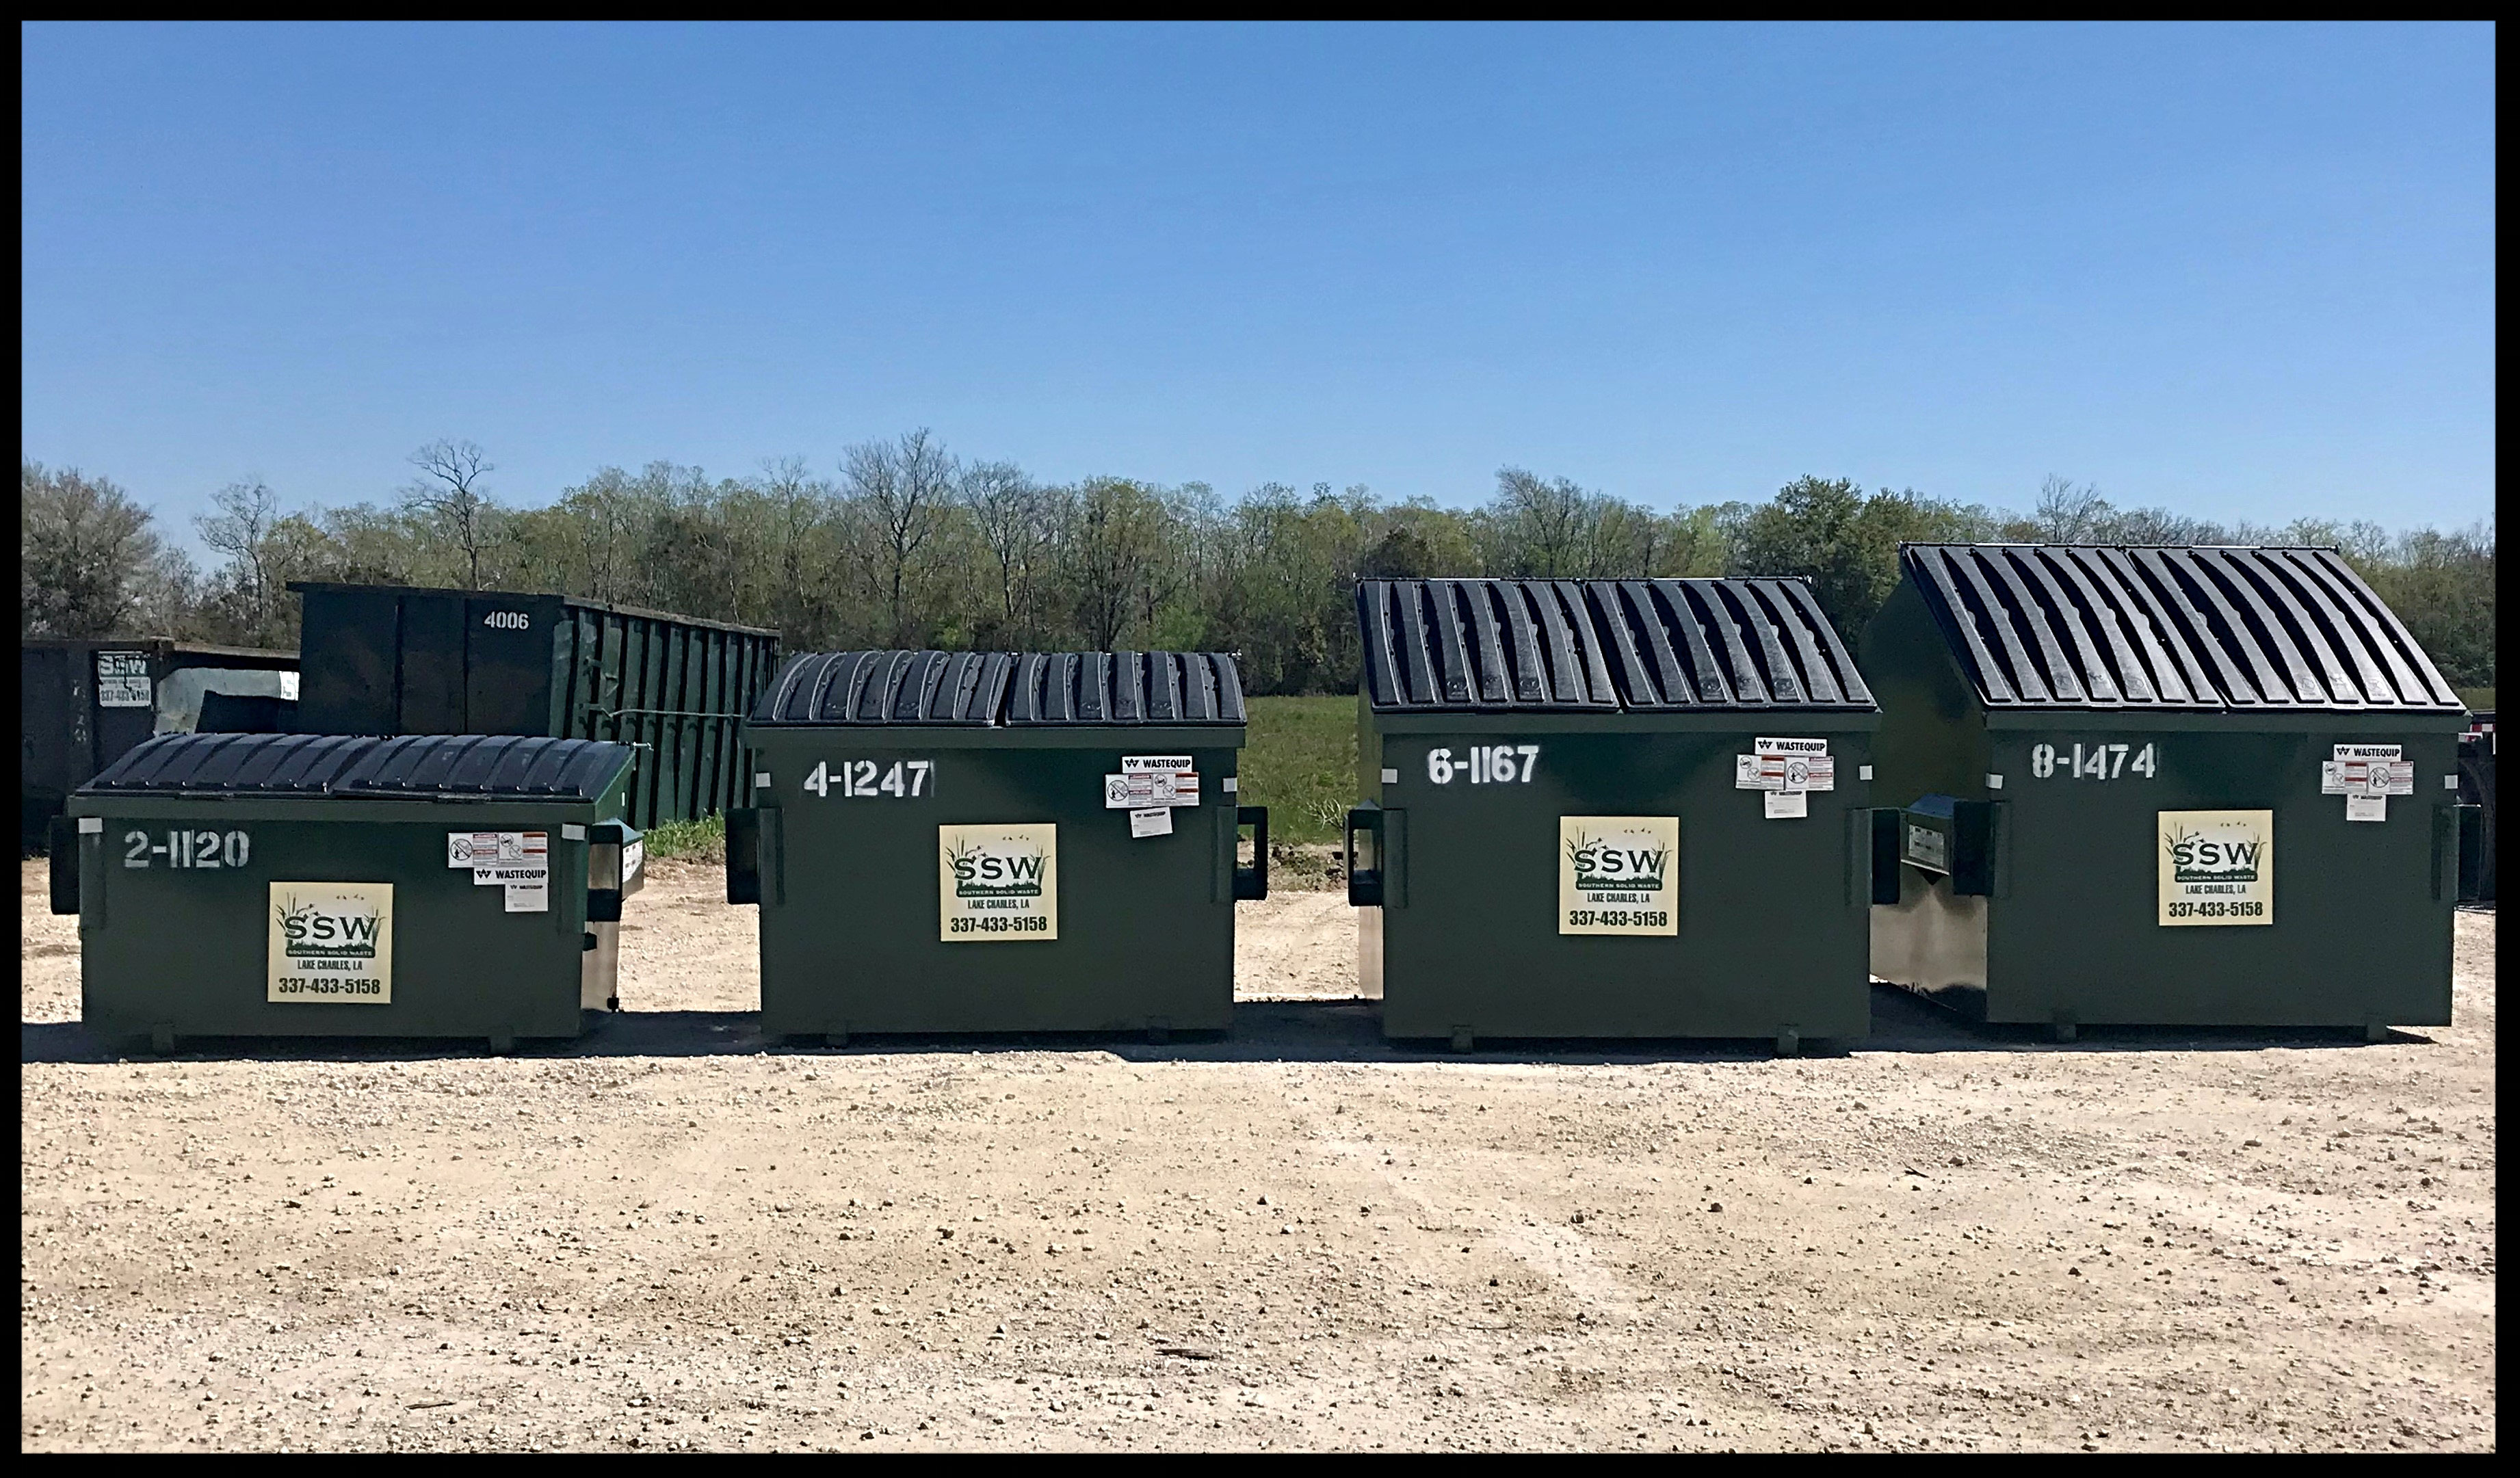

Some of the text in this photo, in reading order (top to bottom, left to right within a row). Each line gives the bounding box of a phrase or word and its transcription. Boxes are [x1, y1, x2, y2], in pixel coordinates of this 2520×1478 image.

[484, 611, 529, 630] 4006
[1776, 741, 1825, 751] WASTEQUIP
[2354, 748, 2400, 757] WASTEQUIP
[1143, 759, 1190, 768] WASTEQUIP
[1428, 745, 1539, 784] 6-1167
[2032, 743, 2155, 780] 8-1474
[804, 760, 929, 797] 4-1247
[124, 830, 250, 868] 2-1120
[2173, 843, 2259, 865] SSW
[954, 856, 1042, 880] SSW
[1574, 849, 1663, 873] SSW
[495, 869, 547, 880] WASTEQUIP
[2186, 884, 2246, 895] LAKE CHARLES, LA
[968, 899, 1030, 910] LAKE CHARLES, LA
[1587, 893, 1650, 904] LAKE CHARLES, LA
[2168, 901, 2263, 917] 337-433-5158
[951, 916, 1047, 933] 337-433-5158
[1569, 910, 1668, 927] 337-433-5158
[284, 916, 376, 940] SSW
[297, 960, 363, 971] LAKE CHARLES, LA
[278, 978, 381, 994] 337-433-5158
